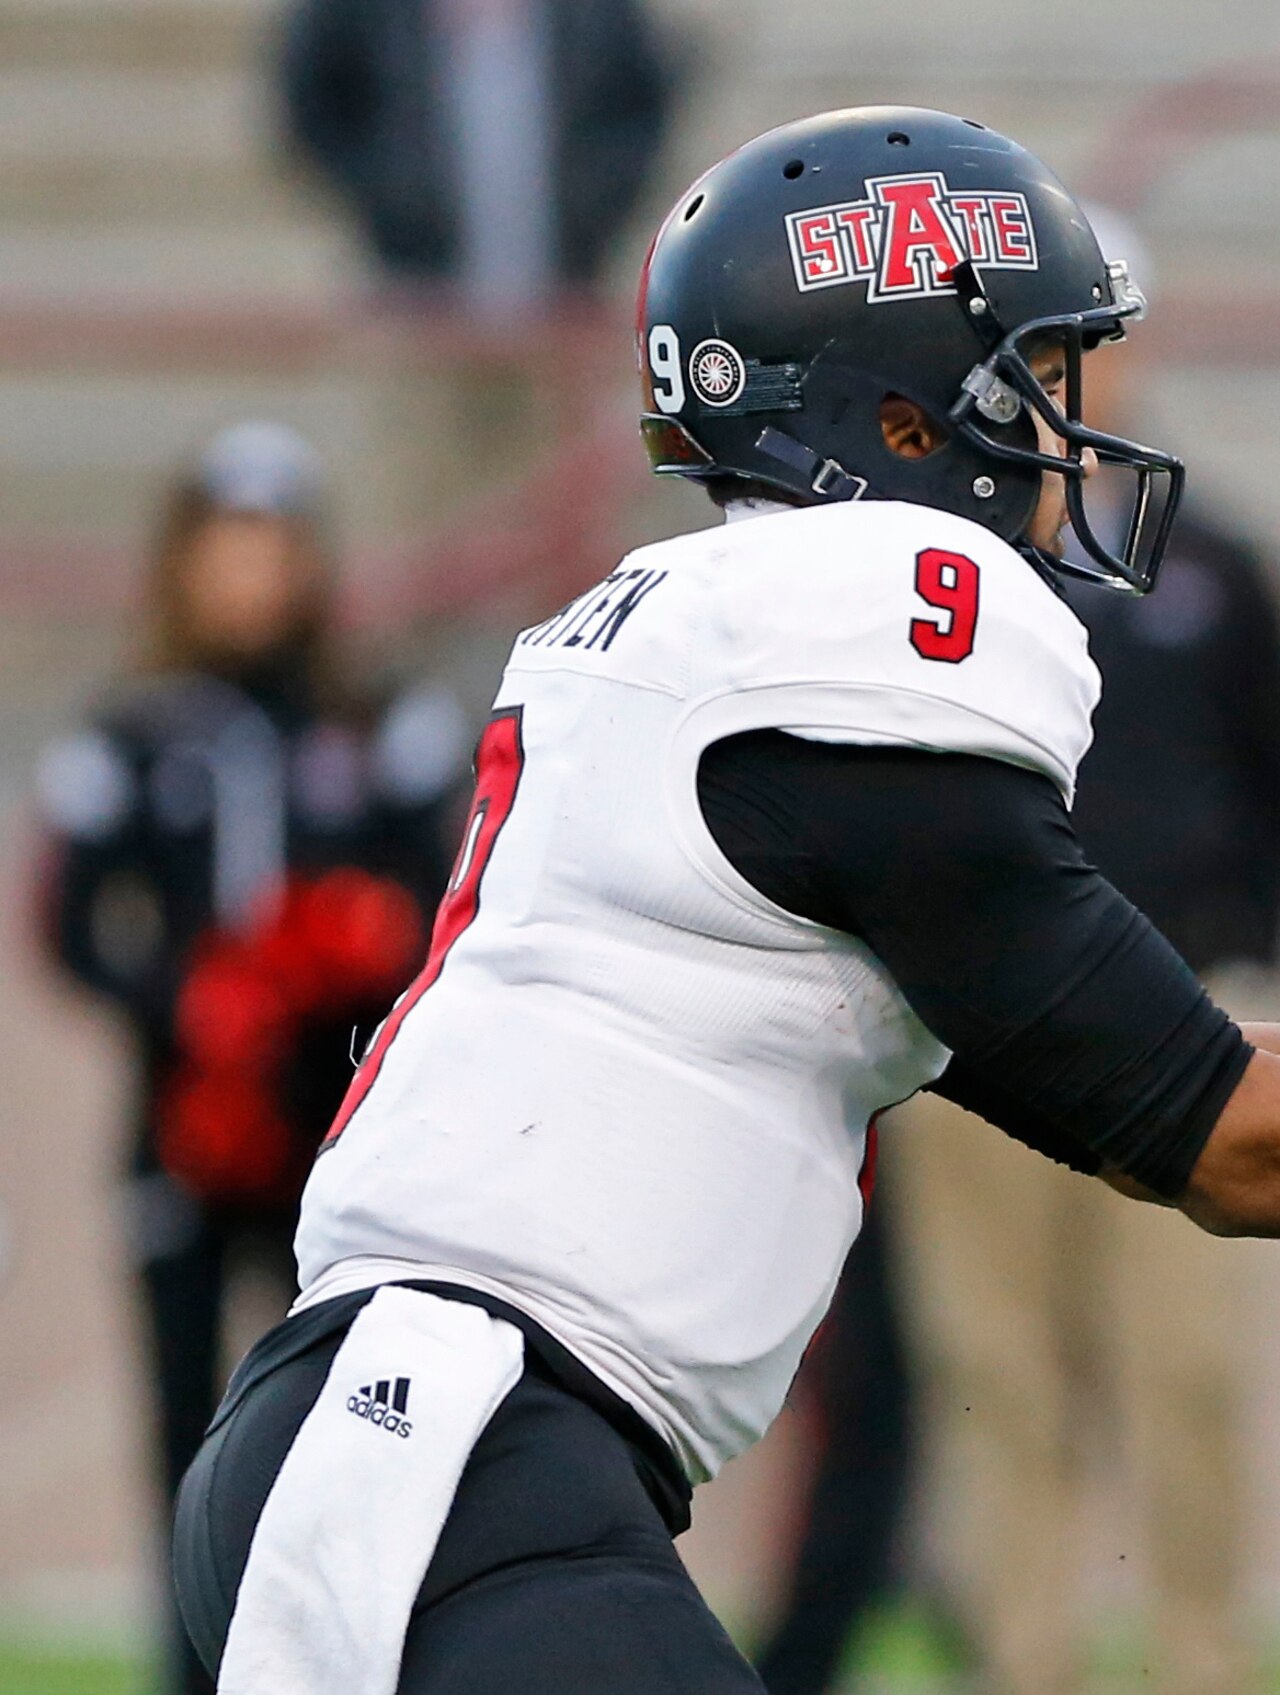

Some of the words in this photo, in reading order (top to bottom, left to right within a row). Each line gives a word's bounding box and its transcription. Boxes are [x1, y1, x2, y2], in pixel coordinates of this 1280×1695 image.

[794, 176, 1033, 294] STATE
[649, 325, 685, 413] 9
[908, 546, 981, 664] 9
[346, 1395, 414, 1439] adidas
